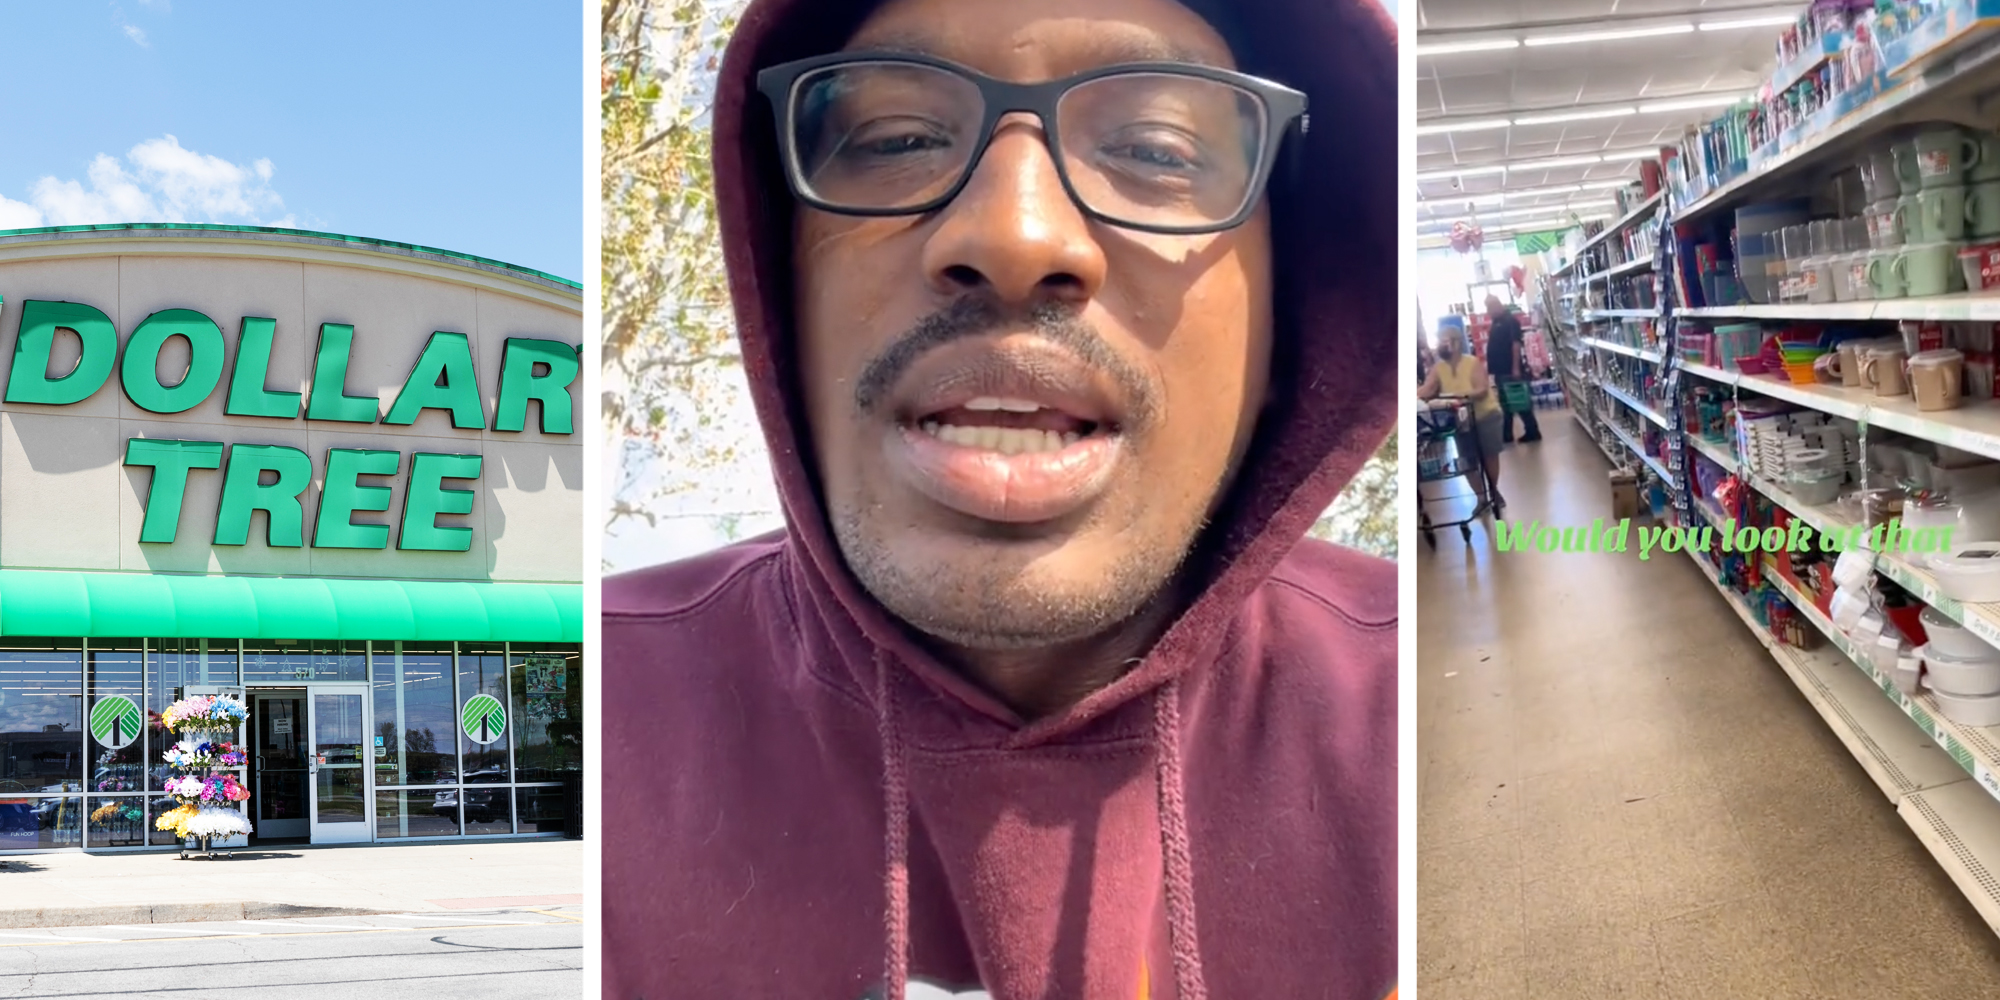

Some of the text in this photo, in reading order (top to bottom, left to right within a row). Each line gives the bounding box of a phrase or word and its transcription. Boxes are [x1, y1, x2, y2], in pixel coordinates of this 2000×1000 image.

[3, 299, 580, 435] DOLLAR
[122, 437, 484, 552] TREE
[295, 667, 315, 679] 570
